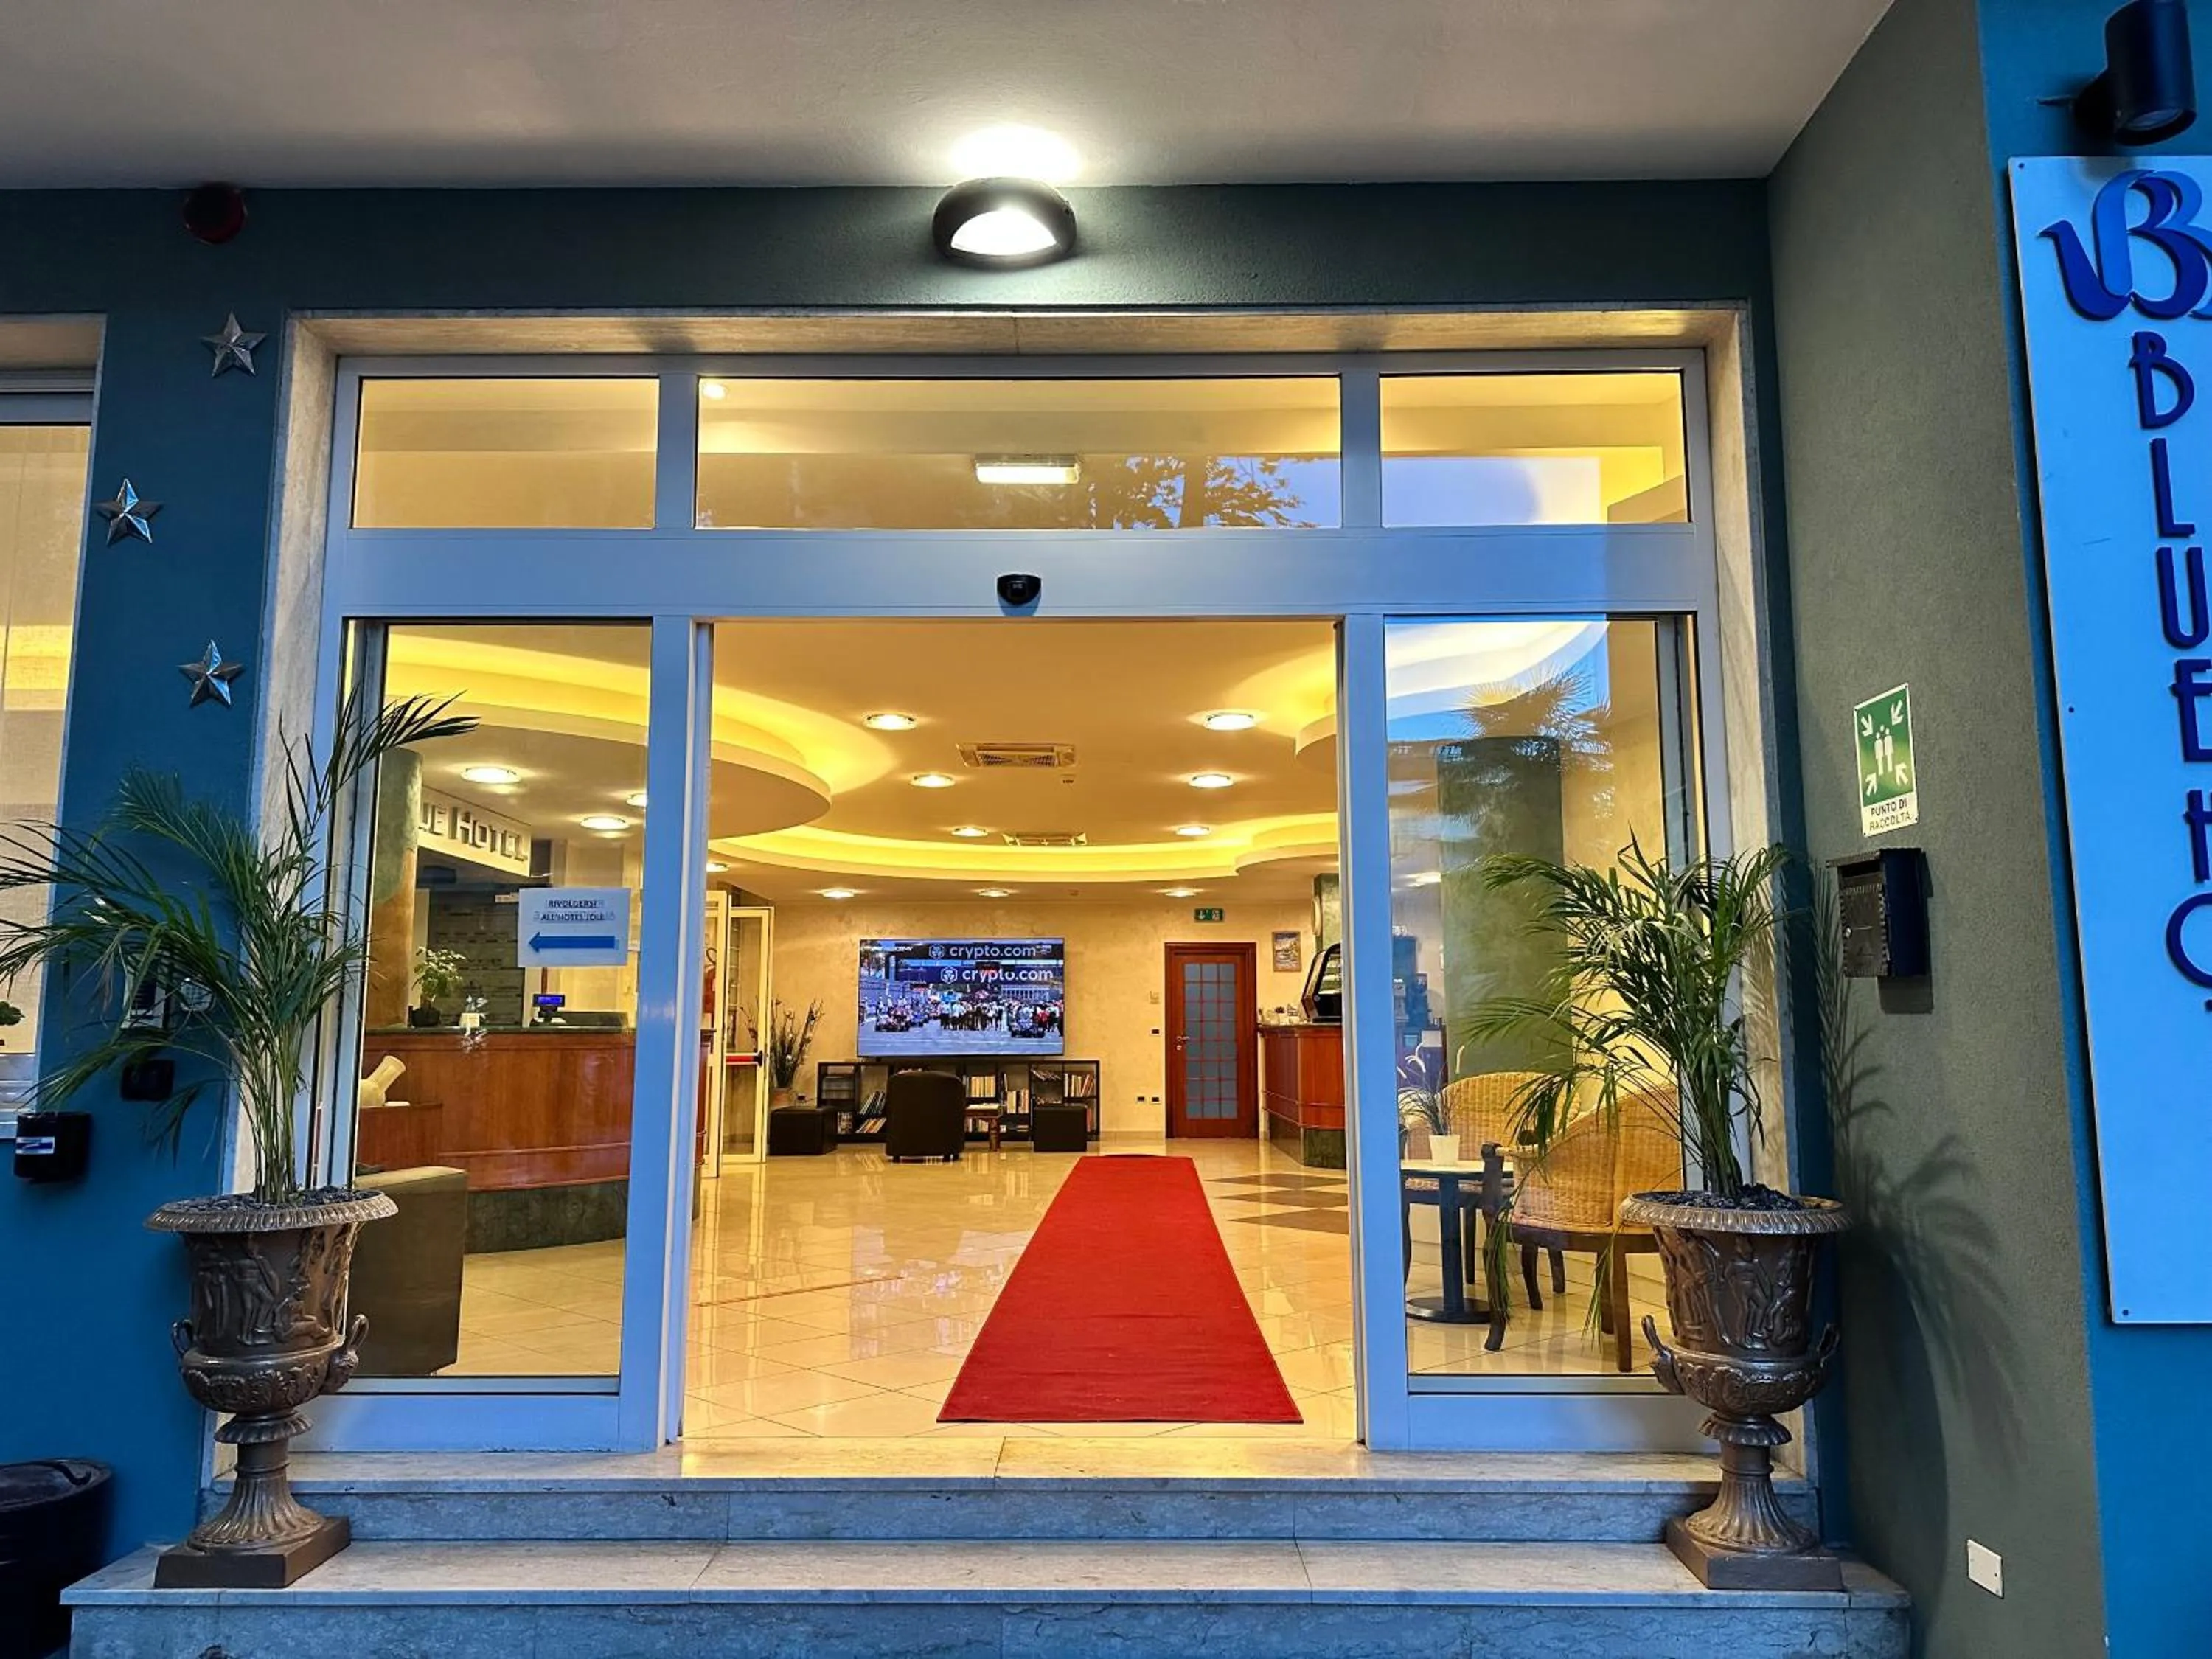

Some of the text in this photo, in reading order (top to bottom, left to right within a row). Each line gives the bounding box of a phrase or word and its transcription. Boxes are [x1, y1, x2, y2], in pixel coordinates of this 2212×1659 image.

[1871, 797, 1907, 817] PUNTO DI
[1869, 810, 1911, 832] RACCOLTA
[949, 945, 1037, 959] crypto.com
[962, 967, 1054, 984] crypto.com
